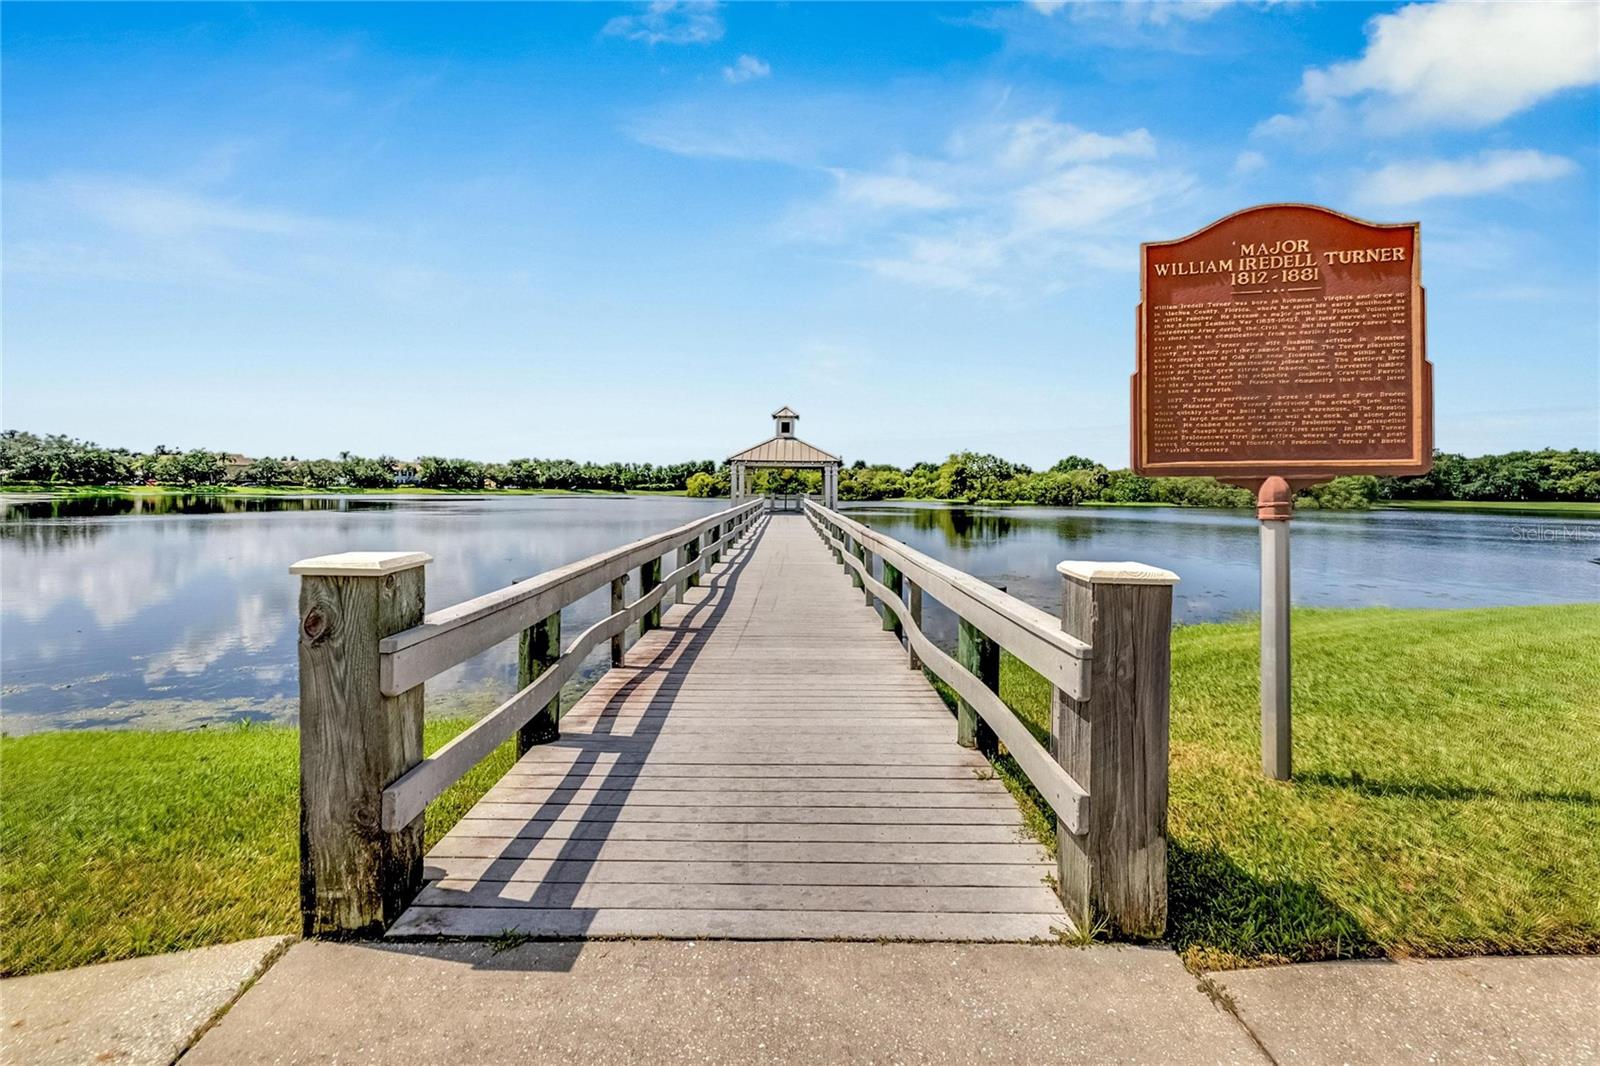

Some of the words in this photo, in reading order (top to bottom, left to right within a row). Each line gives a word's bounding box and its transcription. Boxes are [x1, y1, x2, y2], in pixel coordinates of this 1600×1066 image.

[1240, 239, 1310, 256] MAJOR
[1154, 259, 1233, 276] WILLIAM
[1239, 253, 1318, 271] IREDELL
[1323, 247, 1405, 266] TURNER
